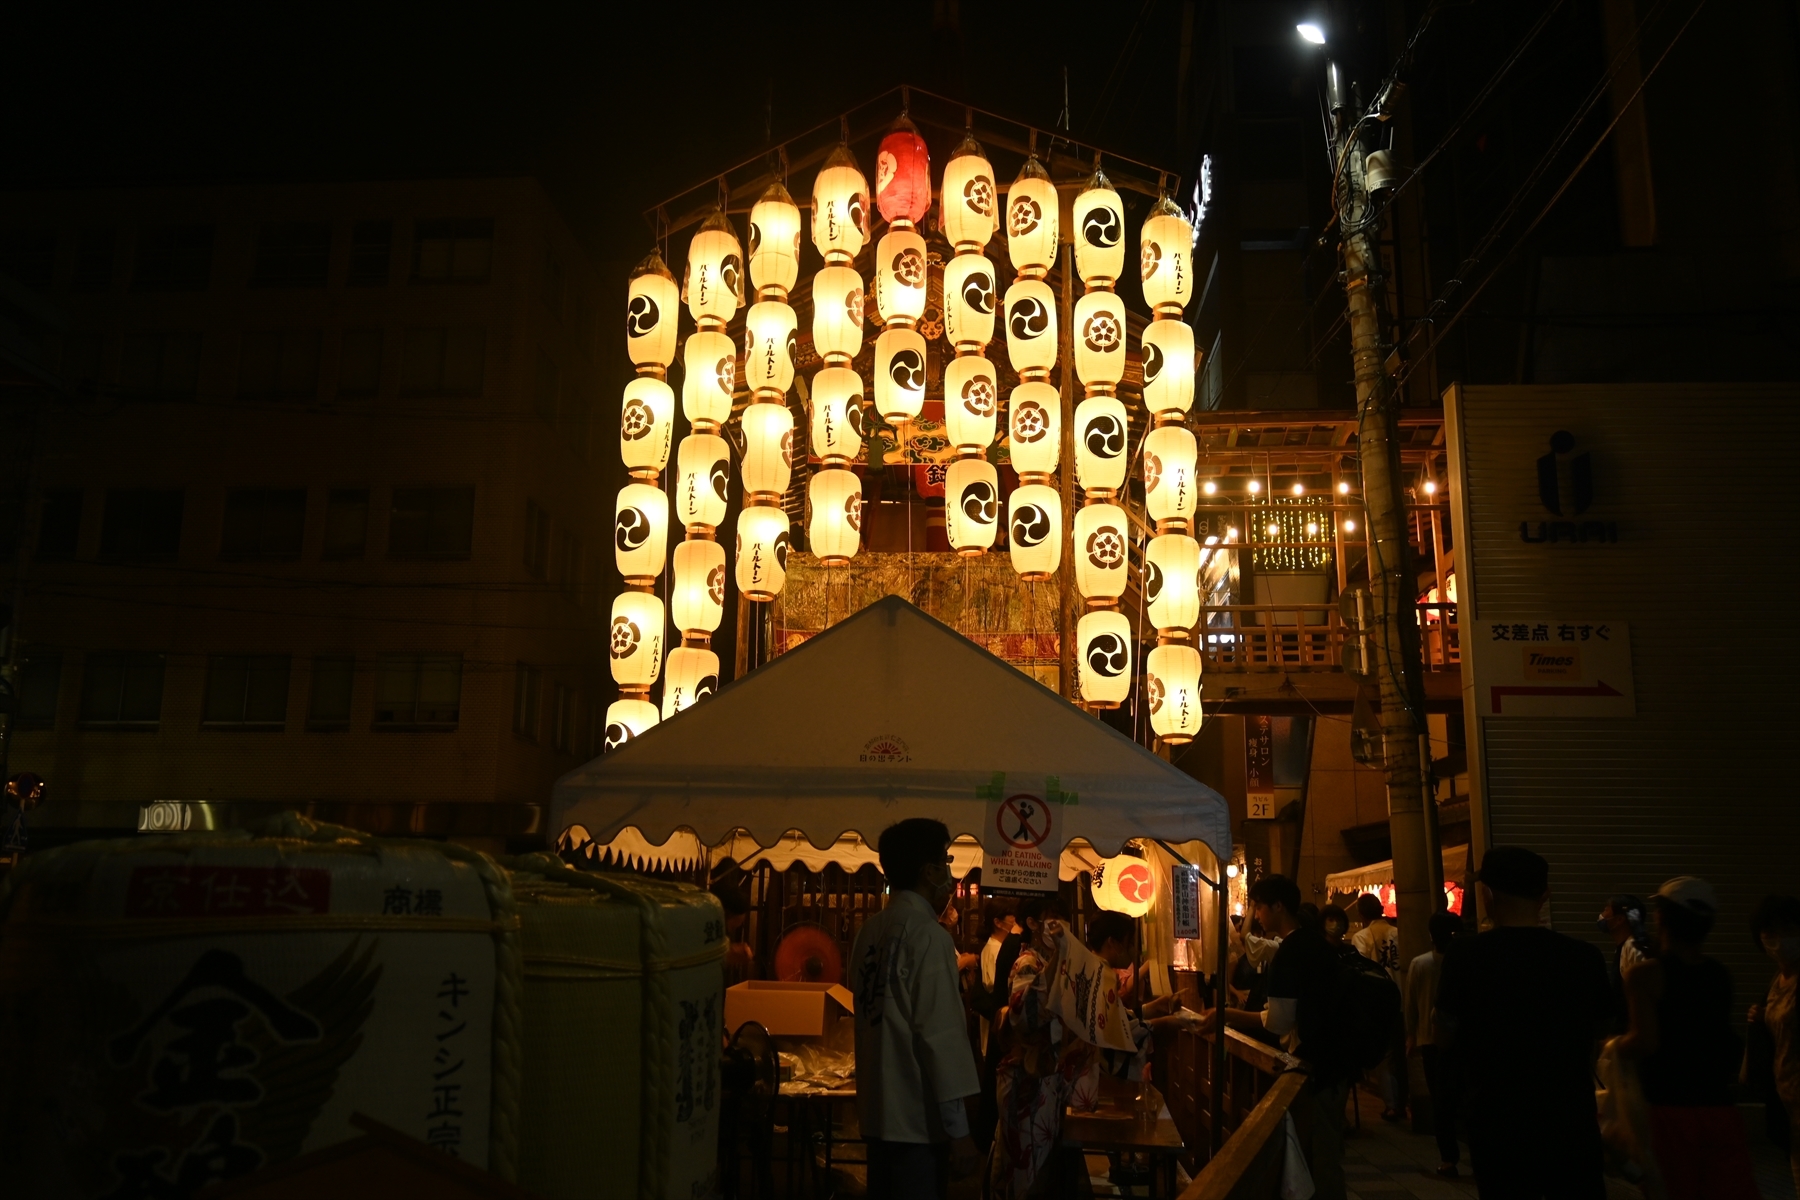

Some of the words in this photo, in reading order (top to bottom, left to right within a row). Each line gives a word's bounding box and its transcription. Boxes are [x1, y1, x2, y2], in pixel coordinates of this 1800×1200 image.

[1521, 521, 1618, 543] URAI
[1492, 624, 1549, 641] 交差点
[1557, 624, 1611, 641] 右すぐ
[1528, 652, 1574, 667] Times
[859, 754, 912, 763] 日の出テント
[1252, 803, 1270, 816] 2F
[1002, 850, 1012, 858] NO
[1015, 851, 1042, 860] EATING
[990, 858, 1014, 866] WHILE
[1017, 859, 1052, 870] WALKING
[993, 868, 1048, 878] 歩きながらの飲食は
[998, 875, 1042, 885] ご遠慮ください
[140, 869, 316, 914] 京仕込
[383, 885, 443, 916] 商標
[426, 972, 470, 1158] キンシ正宗
